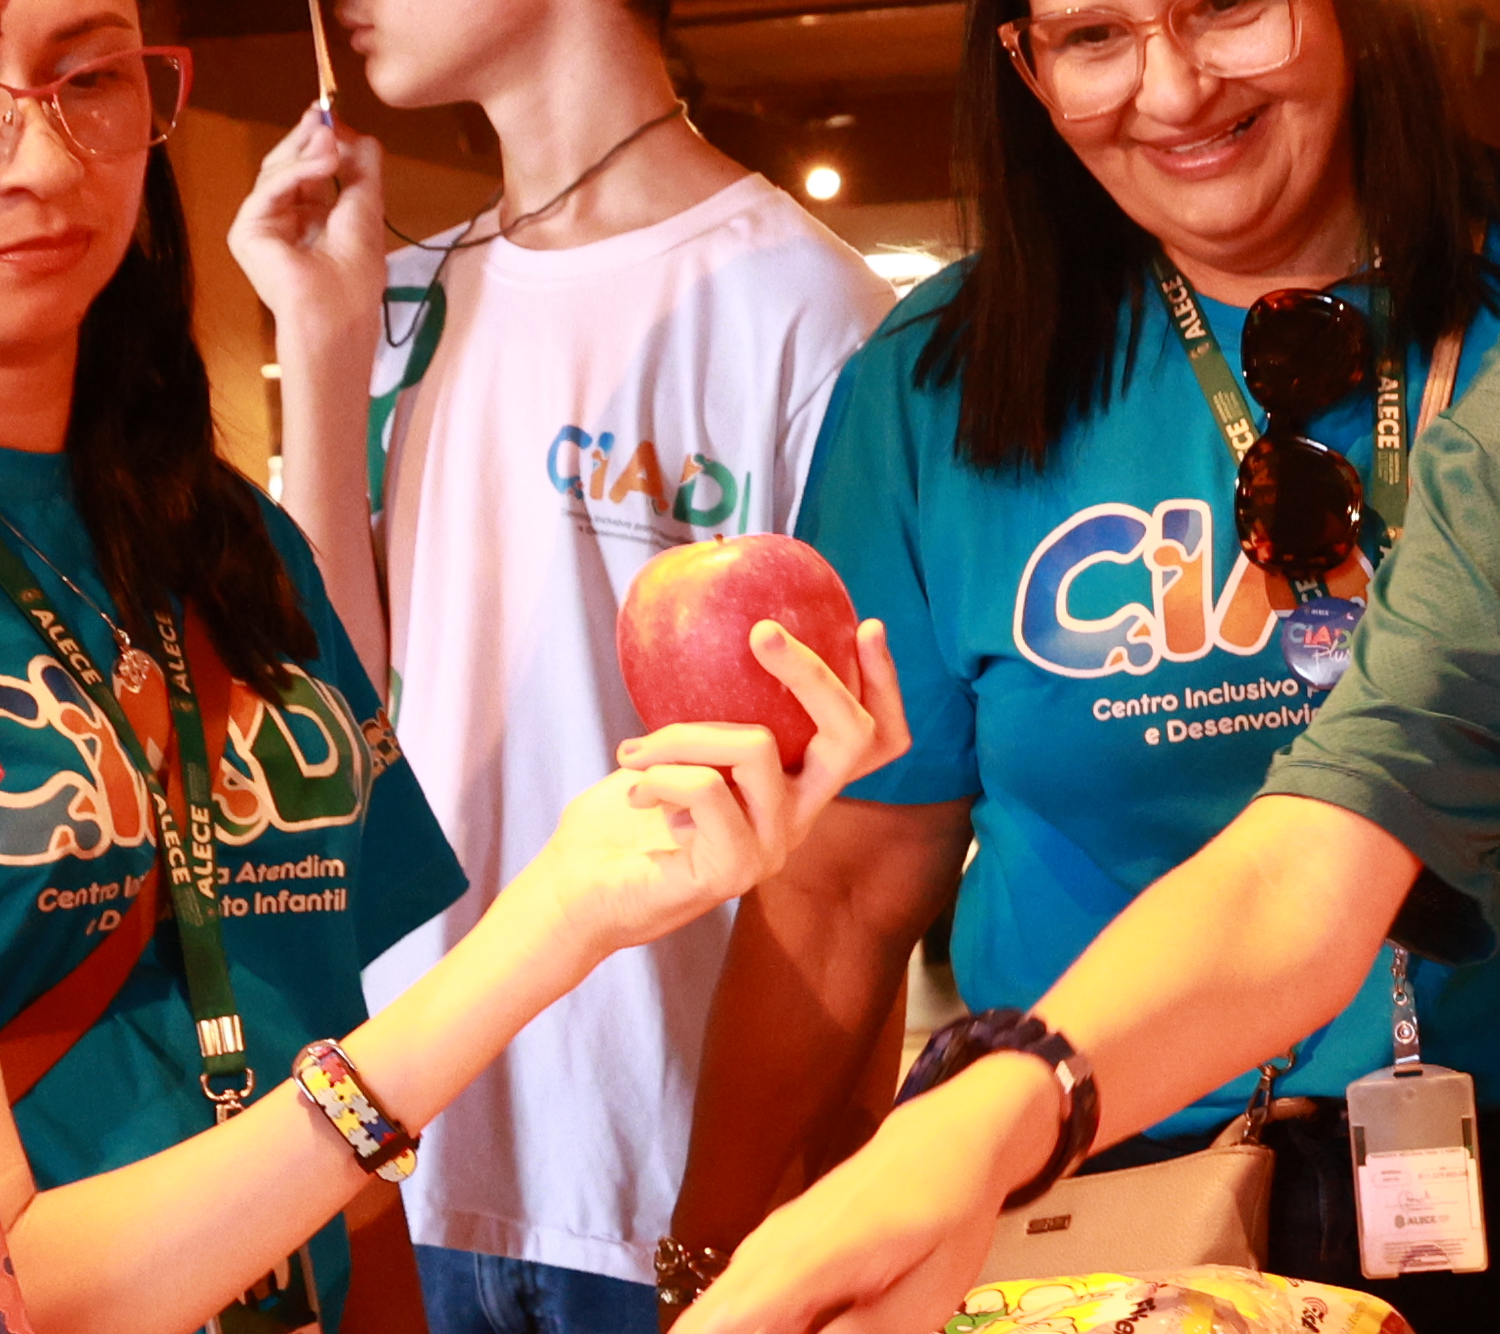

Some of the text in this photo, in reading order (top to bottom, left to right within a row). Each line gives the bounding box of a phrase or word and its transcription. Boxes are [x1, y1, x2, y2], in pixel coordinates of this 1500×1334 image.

[1161, 273, 1207, 342] ALECE
[1376, 375, 1402, 450] ALECE
[30, 607, 104, 687] ALECE
[153, 609, 193, 695] ALECE
[1092, 691, 1180, 722] Centro
[1184, 676, 1299, 709] Inclusivo
[1145, 726, 1161, 746] e
[152, 791, 192, 886] ALECE
[192, 804, 217, 900] ALECE
[37, 882, 120, 912] Centro
[254, 888, 347, 916] Infantil
